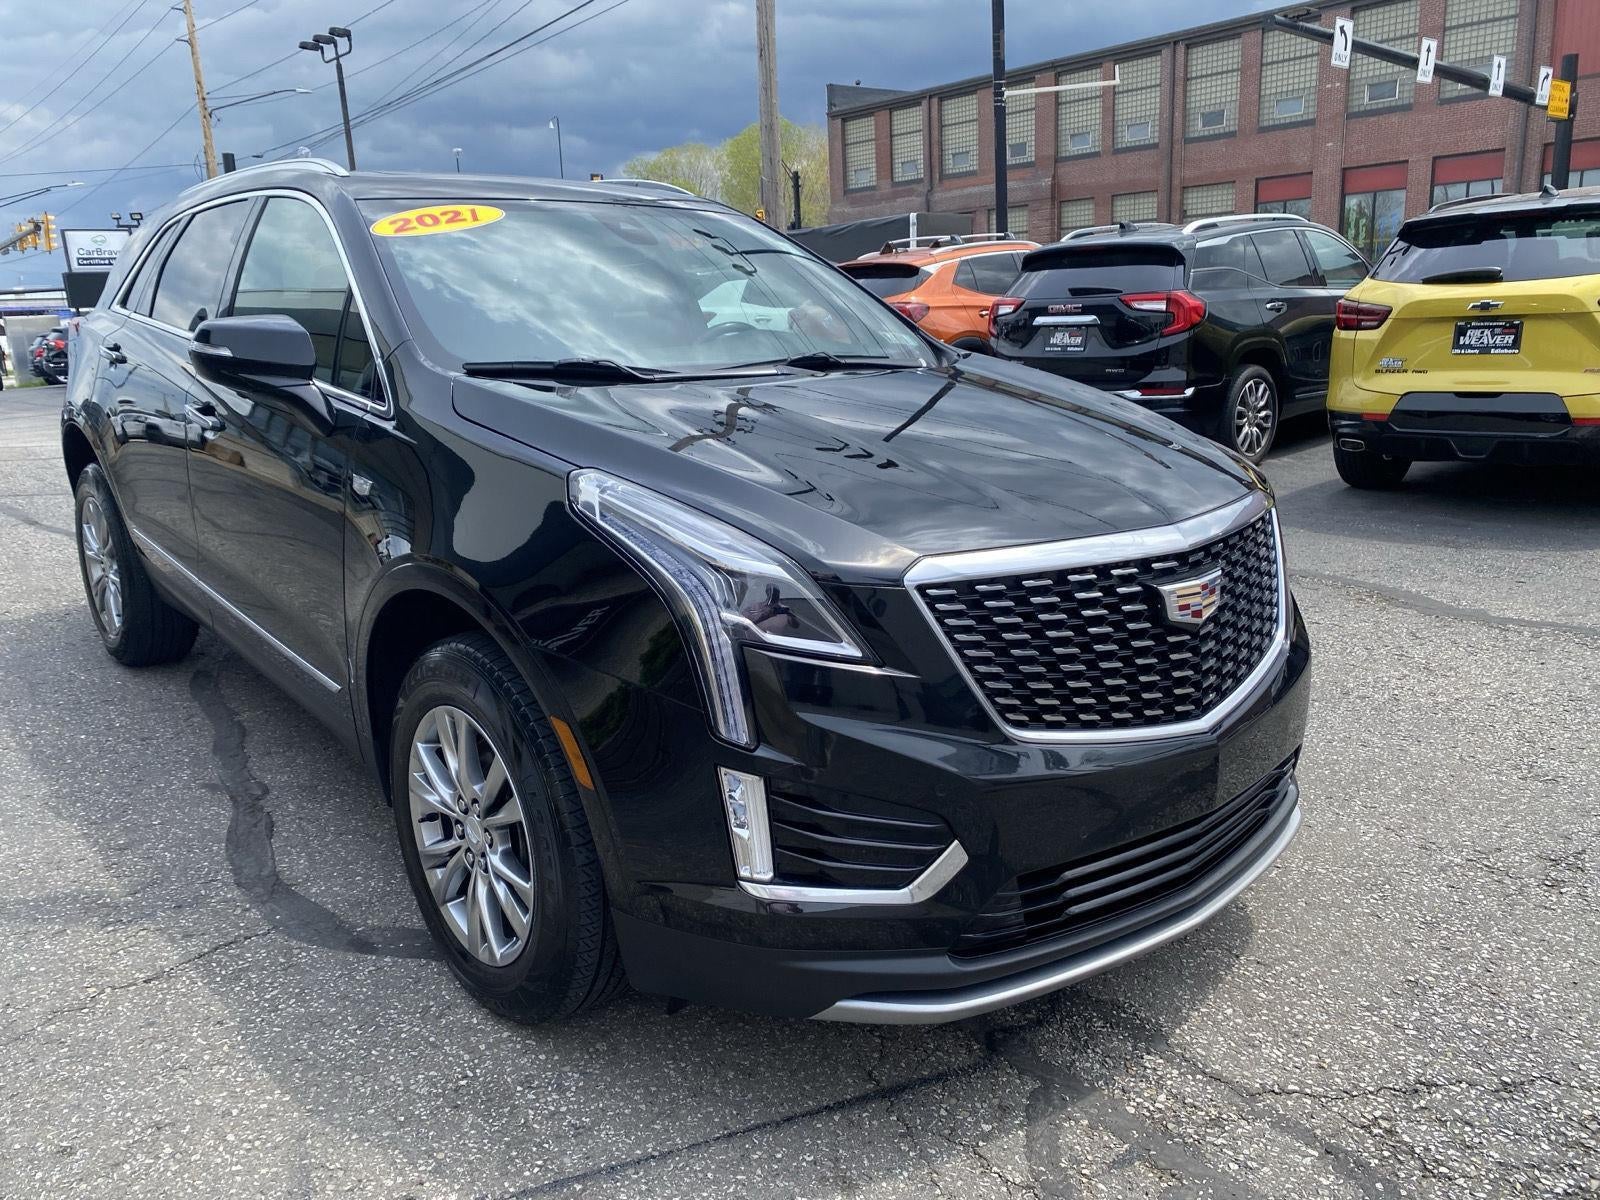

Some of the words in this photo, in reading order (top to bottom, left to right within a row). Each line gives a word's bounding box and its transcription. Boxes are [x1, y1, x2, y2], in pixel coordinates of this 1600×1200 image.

[1334, 52, 1348, 63] ONLY
[388, 207, 480, 234] 2021
[77, 247, 121, 256] CarBrav
[1048, 303, 1082, 313] GMC
[1466, 328, 1493, 337] RICK
[1049, 336, 1083, 344] WEAVER
[1459, 335, 1515, 345] WEAVER
